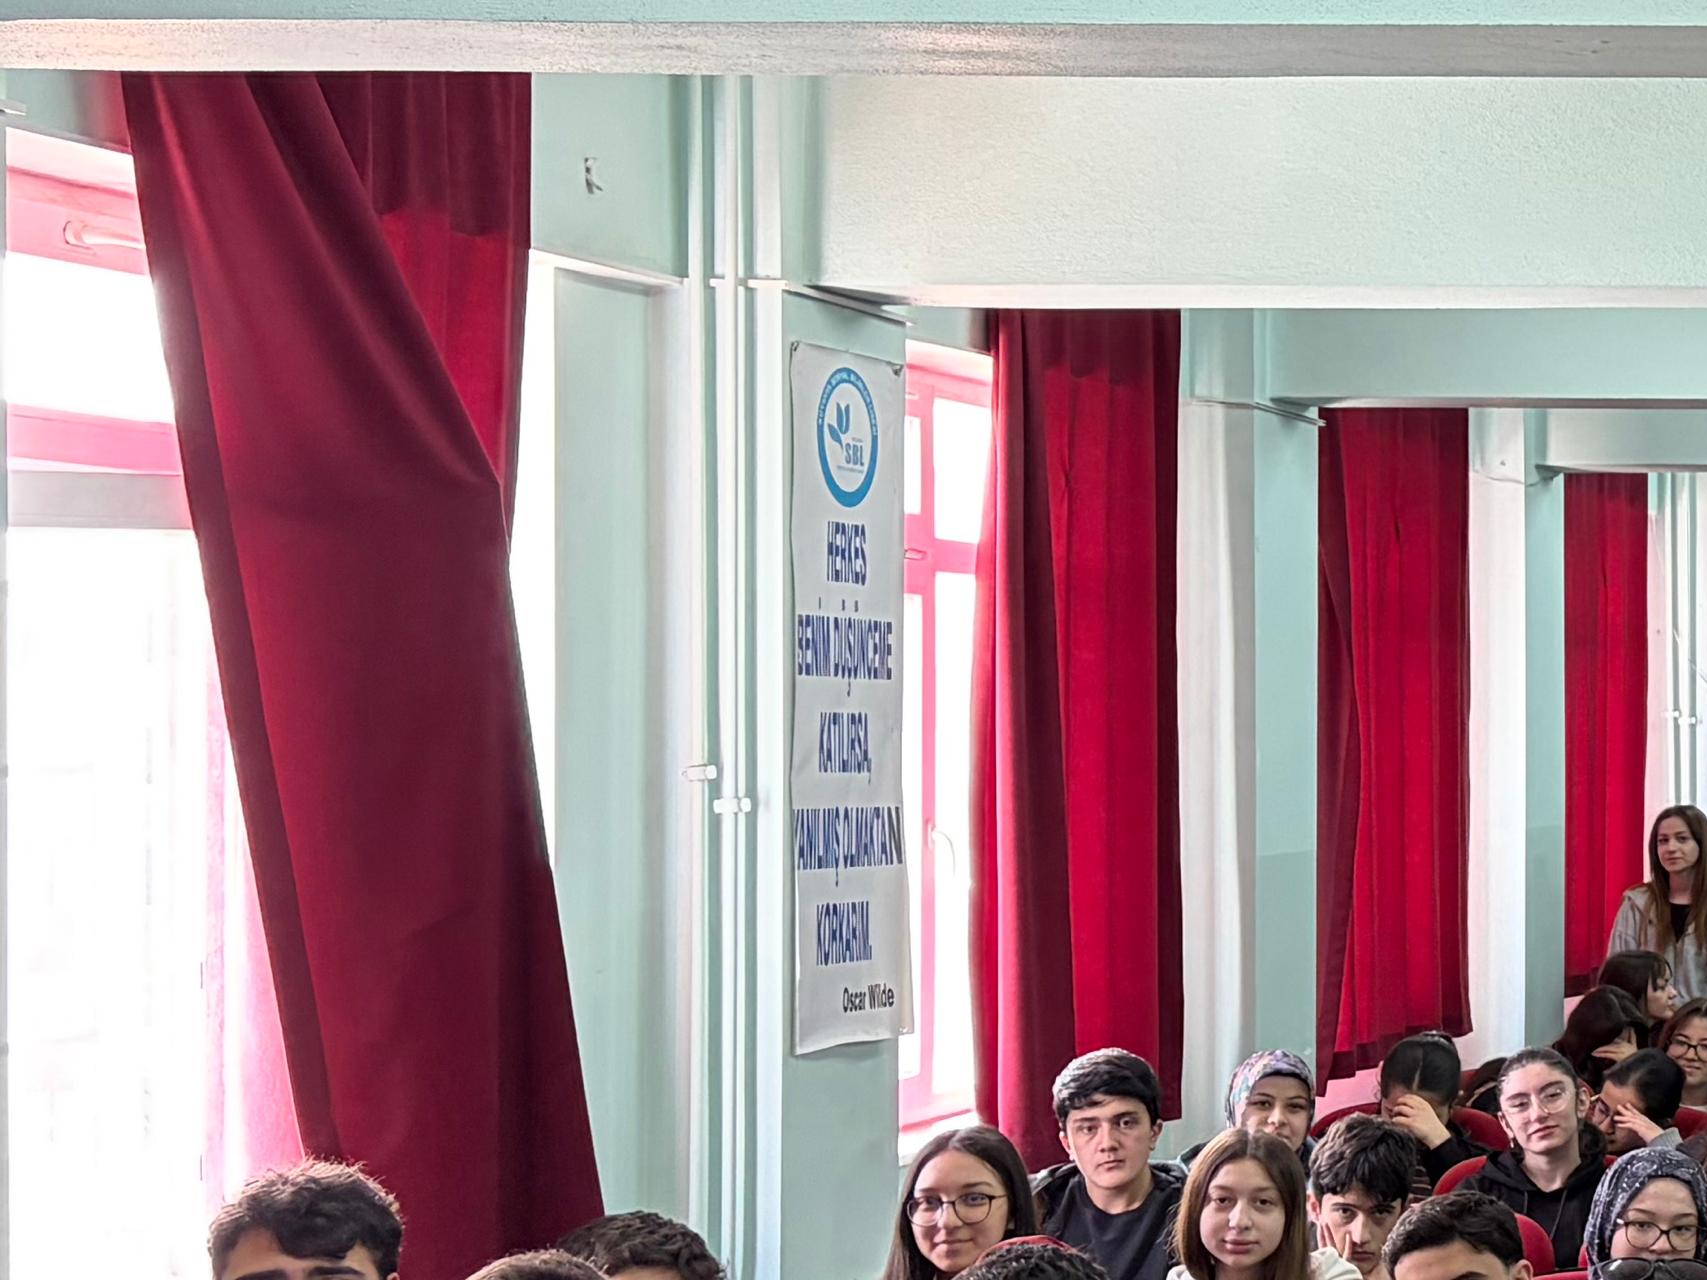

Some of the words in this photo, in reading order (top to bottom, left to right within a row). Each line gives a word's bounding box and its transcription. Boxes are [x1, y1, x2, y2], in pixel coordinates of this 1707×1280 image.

[827, 520, 867, 586] HERKES
[843, 806, 903, 869] OLMAKTAN
[816, 900, 872, 966] KORKARIM.
[842, 986, 866, 1013] Oscar
[868, 983, 895, 1010] Wilde
